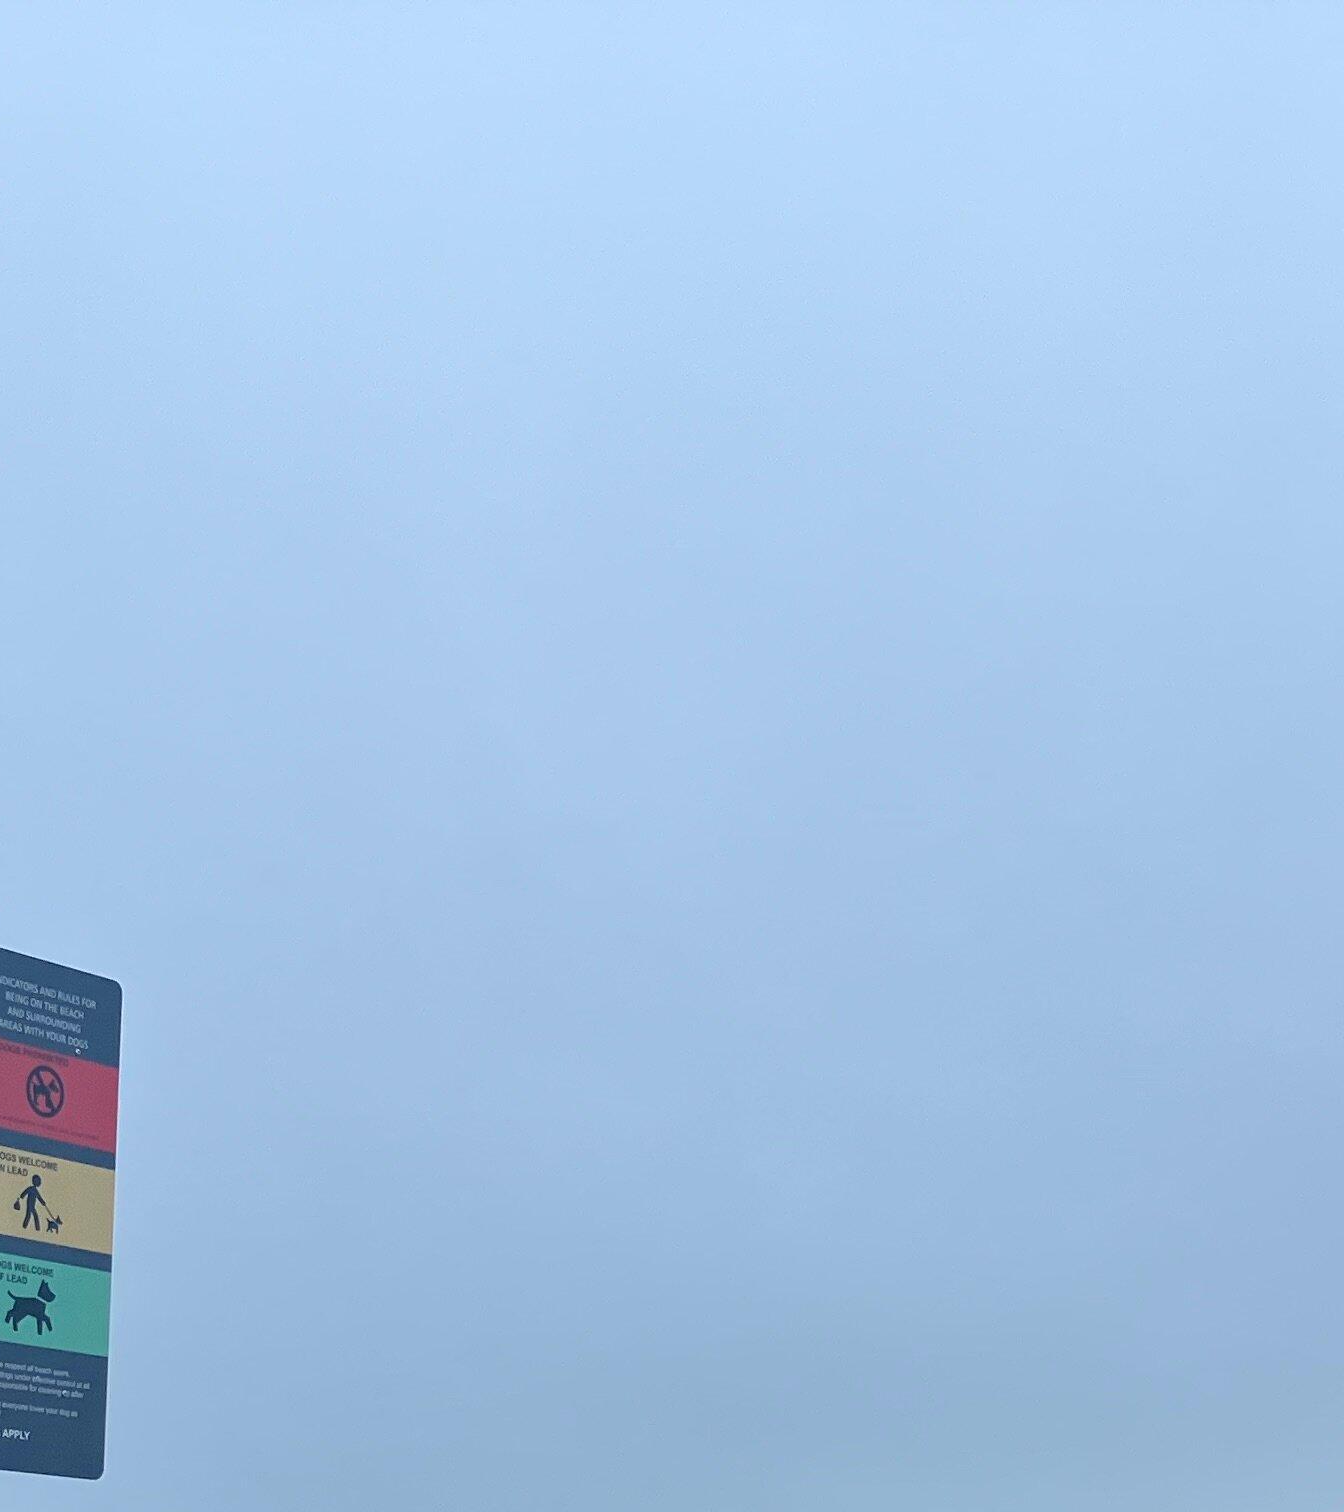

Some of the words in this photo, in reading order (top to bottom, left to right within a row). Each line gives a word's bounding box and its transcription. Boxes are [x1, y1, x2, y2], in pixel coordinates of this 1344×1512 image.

[39, 986, 56, 998] AND
[57, 991, 80, 1005] RULES
[81, 998, 96, 1009] FOR
[30, 998, 43, 1009] ON
[44, 1001, 57, 1013] THE
[60, 1006, 84, 1019] BEACH
[23, 1024, 44, 1037] WITH
[45, 1031, 66, 1044] YOUR
[67, 1036, 89, 1050] DOGS
[7, 1166, 28, 1176] LEAD
[18, 1155, 58, 1171] WELCOME
[14, 1261, 54, 1277] WELCOME
[6, 1273, 28, 1284] LEAD
[2, 1428, 31, 1440] APPLY
